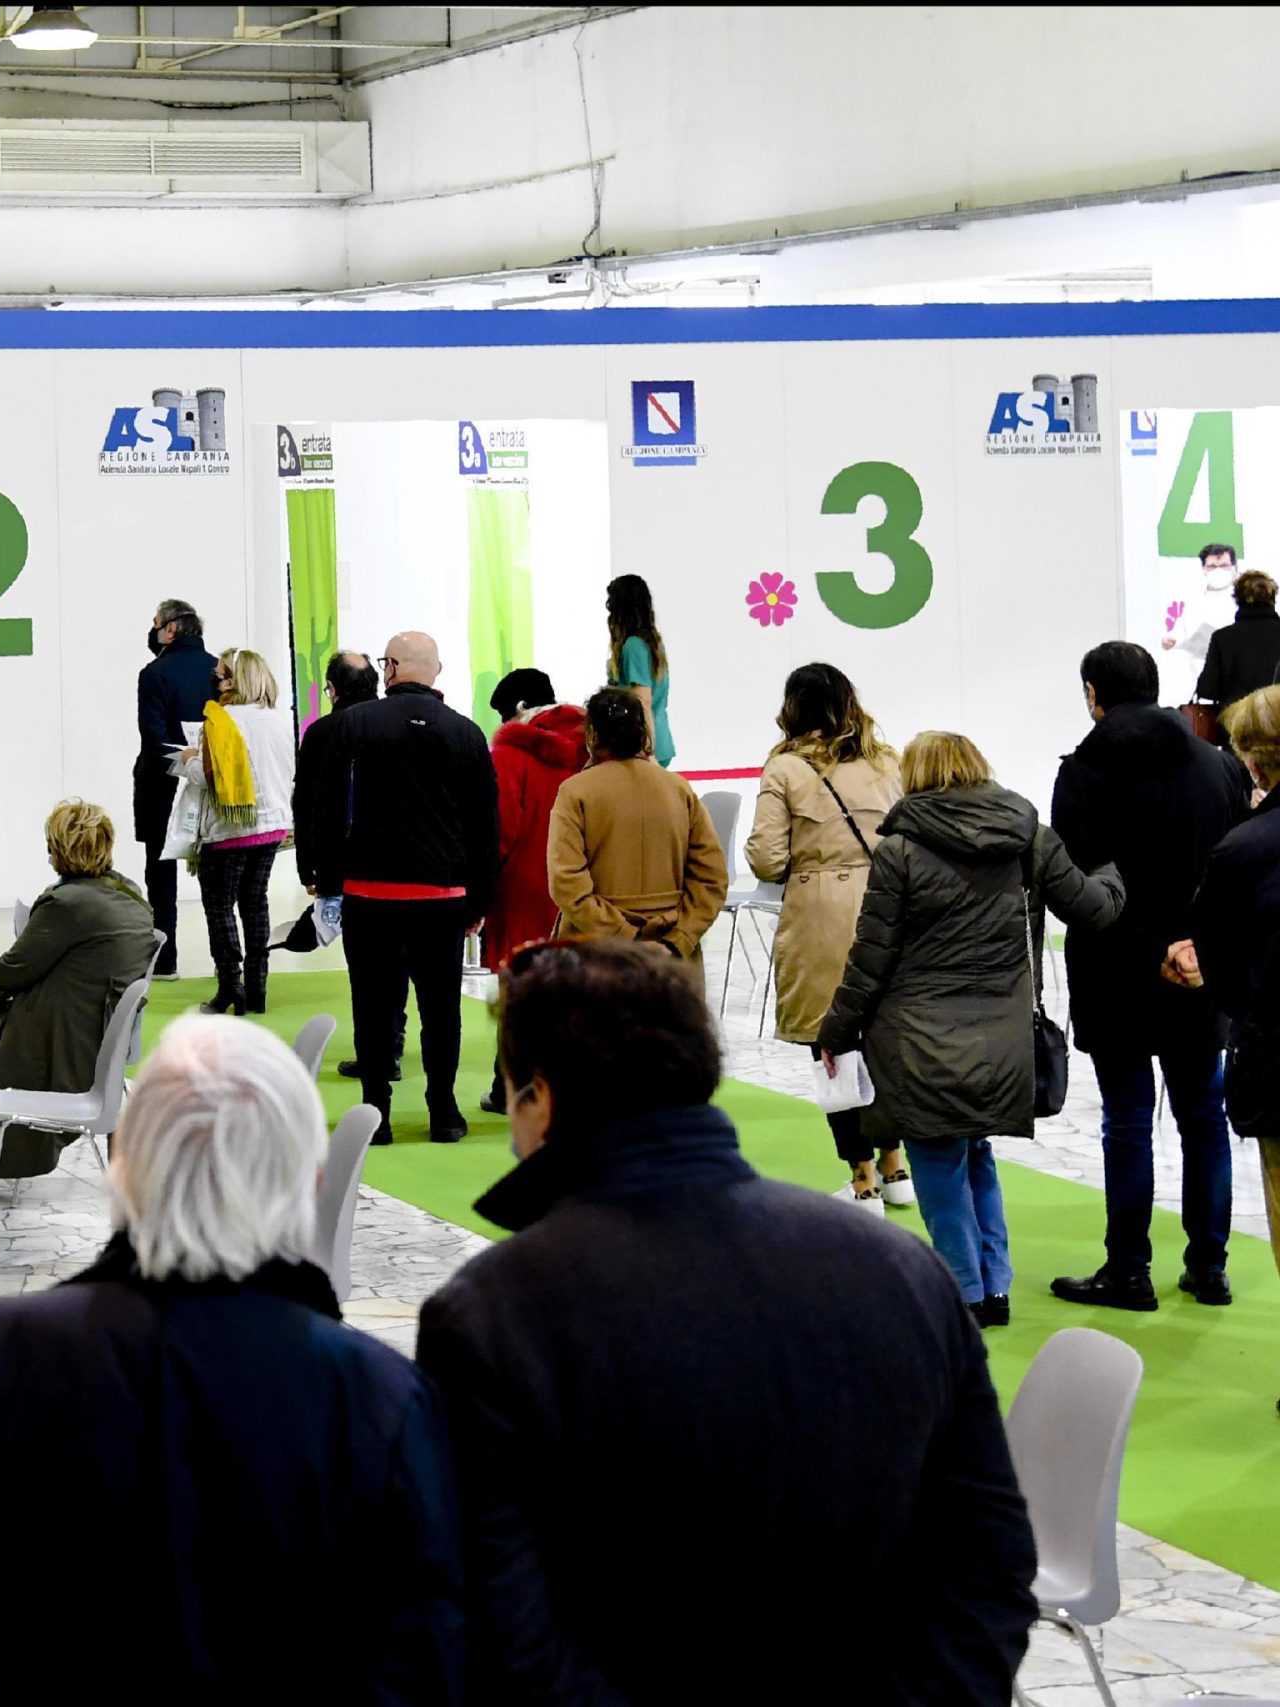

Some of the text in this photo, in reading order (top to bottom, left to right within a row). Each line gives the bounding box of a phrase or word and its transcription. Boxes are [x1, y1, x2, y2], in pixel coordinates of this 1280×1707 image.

[987, 391, 1071, 434] ASL
[102, 406, 195, 452] ASL
[489, 428, 525, 448] entrata
[986, 433, 1102, 444] REGIONE CAMPANIA
[301, 432, 332, 452] entrata
[624, 446, 706, 456] REGIONE CAMPANIA
[986, 446, 1010, 455] Azienda
[1010, 446, 1037, 455] Sanitaria
[1037, 446, 1057, 455] Locale
[1057, 446, 1076, 456] Napoli
[1082, 445, 1102, 455] Centro
[100, 452, 230, 462] REGIONE CAMPANIA
[100, 465, 127, 474] Azienda
[127, 464, 157, 474] Sanitaria
[158, 464, 180, 474] Locale
[180, 465, 201, 475] Napoli
[207, 464, 230, 474] Centro
[1157, 410, 1245, 560] 4
[816, 461, 934, 630] 3
